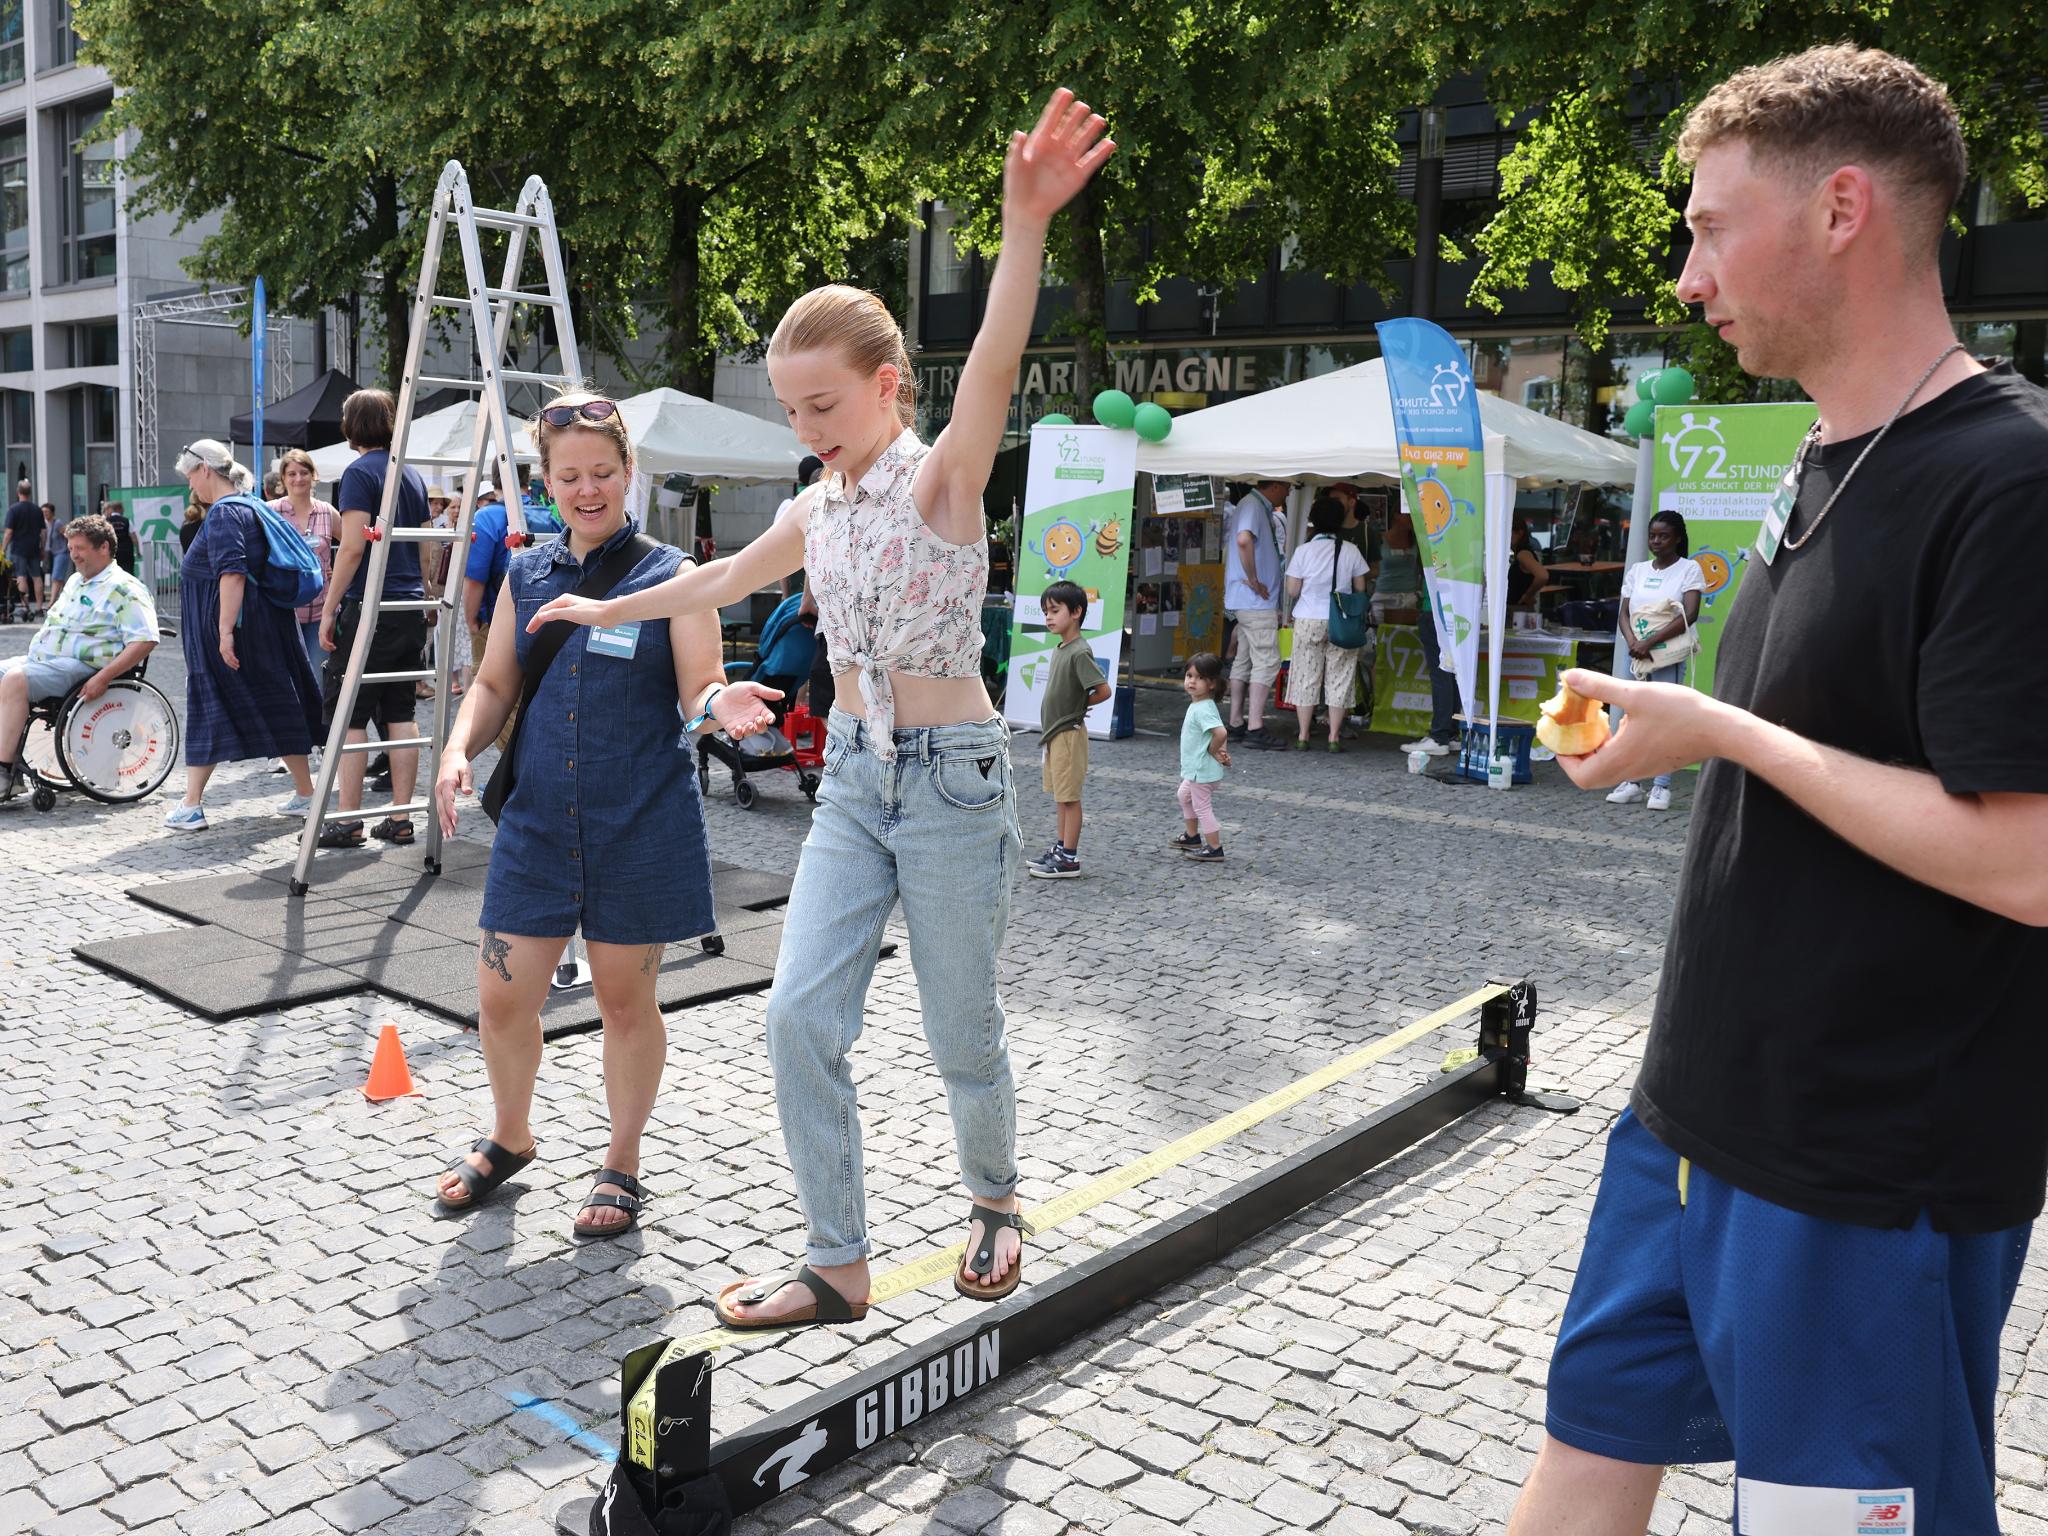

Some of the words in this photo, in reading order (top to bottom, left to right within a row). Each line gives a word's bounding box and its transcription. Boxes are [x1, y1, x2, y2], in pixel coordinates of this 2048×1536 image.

[1063, 448, 1080, 462] 72
[1680, 446, 1727, 479] 72
[1729, 465, 1791, 479] STUNDE
[1679, 482, 1697, 490] UNS
[1701, 482, 1738, 490] SCHICKT
[1744, 482, 1762, 490] DER
[1678, 495, 1696, 505] Die
[1700, 495, 1767, 506] Sozialaktion
[1709, 507, 1719, 517] in
[1724, 507, 1768, 517] Deutsch
[1392, 647, 1431, 680] 72
[856, 1328, 1000, 1450] GIBBON
[635, 1417, 647, 1468] CLAS
